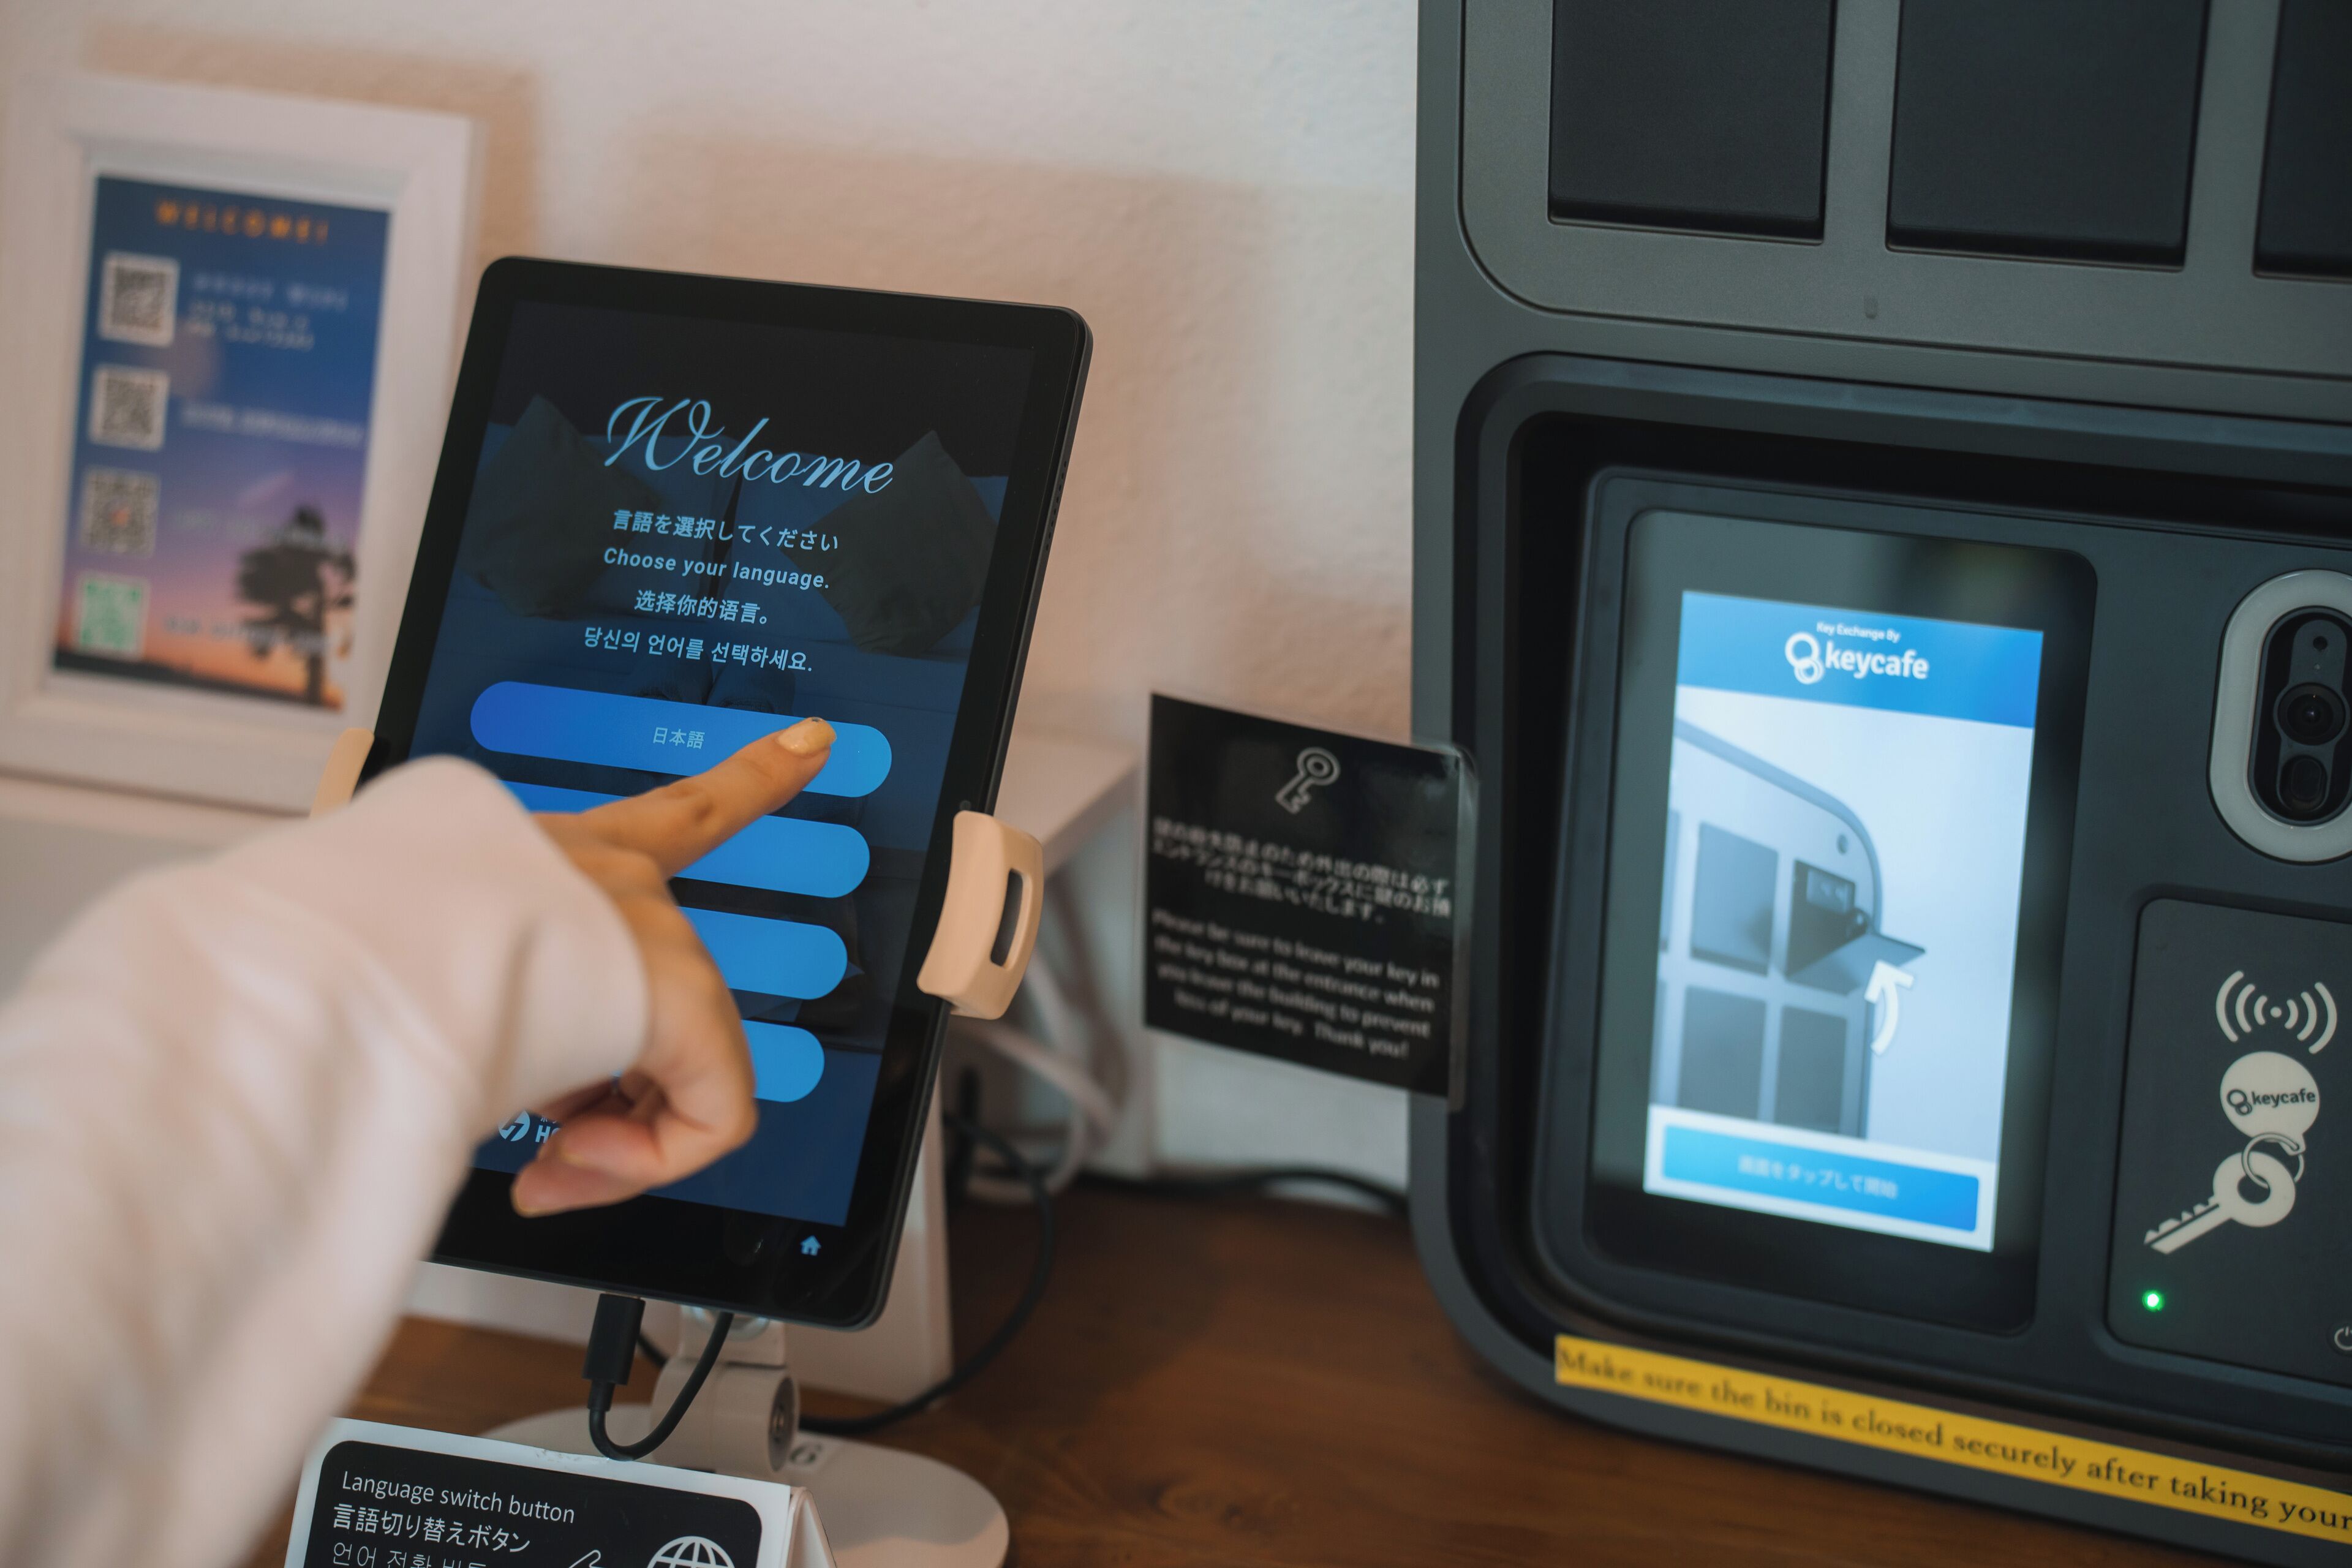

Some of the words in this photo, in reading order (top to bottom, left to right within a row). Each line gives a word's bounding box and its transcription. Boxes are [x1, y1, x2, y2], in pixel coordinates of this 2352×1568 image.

[604, 396, 894, 494] Welcome
[613, 509, 839, 552] 言語を選択してください
[604, 547, 676, 571] Choose
[682, 559, 727, 578] your
[733, 561, 830, 590] language.
[634, 590, 768, 625] 选择你的语言。
[584, 627, 641, 654] 당신의
[647, 635, 704, 662] 언어를
[711, 642, 813, 673] 선택하세요.
[1817, 621, 1835, 636] Key
[1836, 623, 1885, 641] Exchange
[1887, 628, 1901, 643] By
[1825, 641, 1929, 680] keycafe
[652, 727, 705, 749] 日本語
[1273, 936, 1293, 956] to
[1295, 941, 1340, 967] leave
[1344, 956, 1384, 978] your
[1387, 961, 1417, 987] key
[1421, 967, 1440, 988] in
[1272, 960, 1302, 982] the
[1304, 969, 1382, 1003] entrance
[1384, 987, 1435, 1014] when
[1236, 979, 1267, 1001] the
[1268, 985, 1338, 1022] building
[1340, 1004, 1360, 1024] to
[1362, 1011, 1431, 1039] prevent
[1315, 1020, 1364, 1050] Thank
[2252, 1088, 2316, 1108] keycafe
[1558, 1349, 1633, 1384] Make
[1643, 1370, 1701, 1397] sure
[1711, 1378, 1755, 1407] the
[1765, 1387, 1811, 1423] bin
[1822, 1400, 1842, 1425] is
[1852, 1409, 1943, 1447] closed
[1953, 1433, 2076, 1477] securely
[2087, 1458, 2159, 1490] after
[2170, 1477, 2269, 1518] taking
[2279, 1500, 2352, 1531] your
[342, 1471, 434, 1504] Language
[440, 1489, 502, 1512] switch
[509, 1495, 575, 1524] button
[333, 1503, 530, 1553] 言語切り替えボタン
[333, 1542, 377, 1568] 언어
